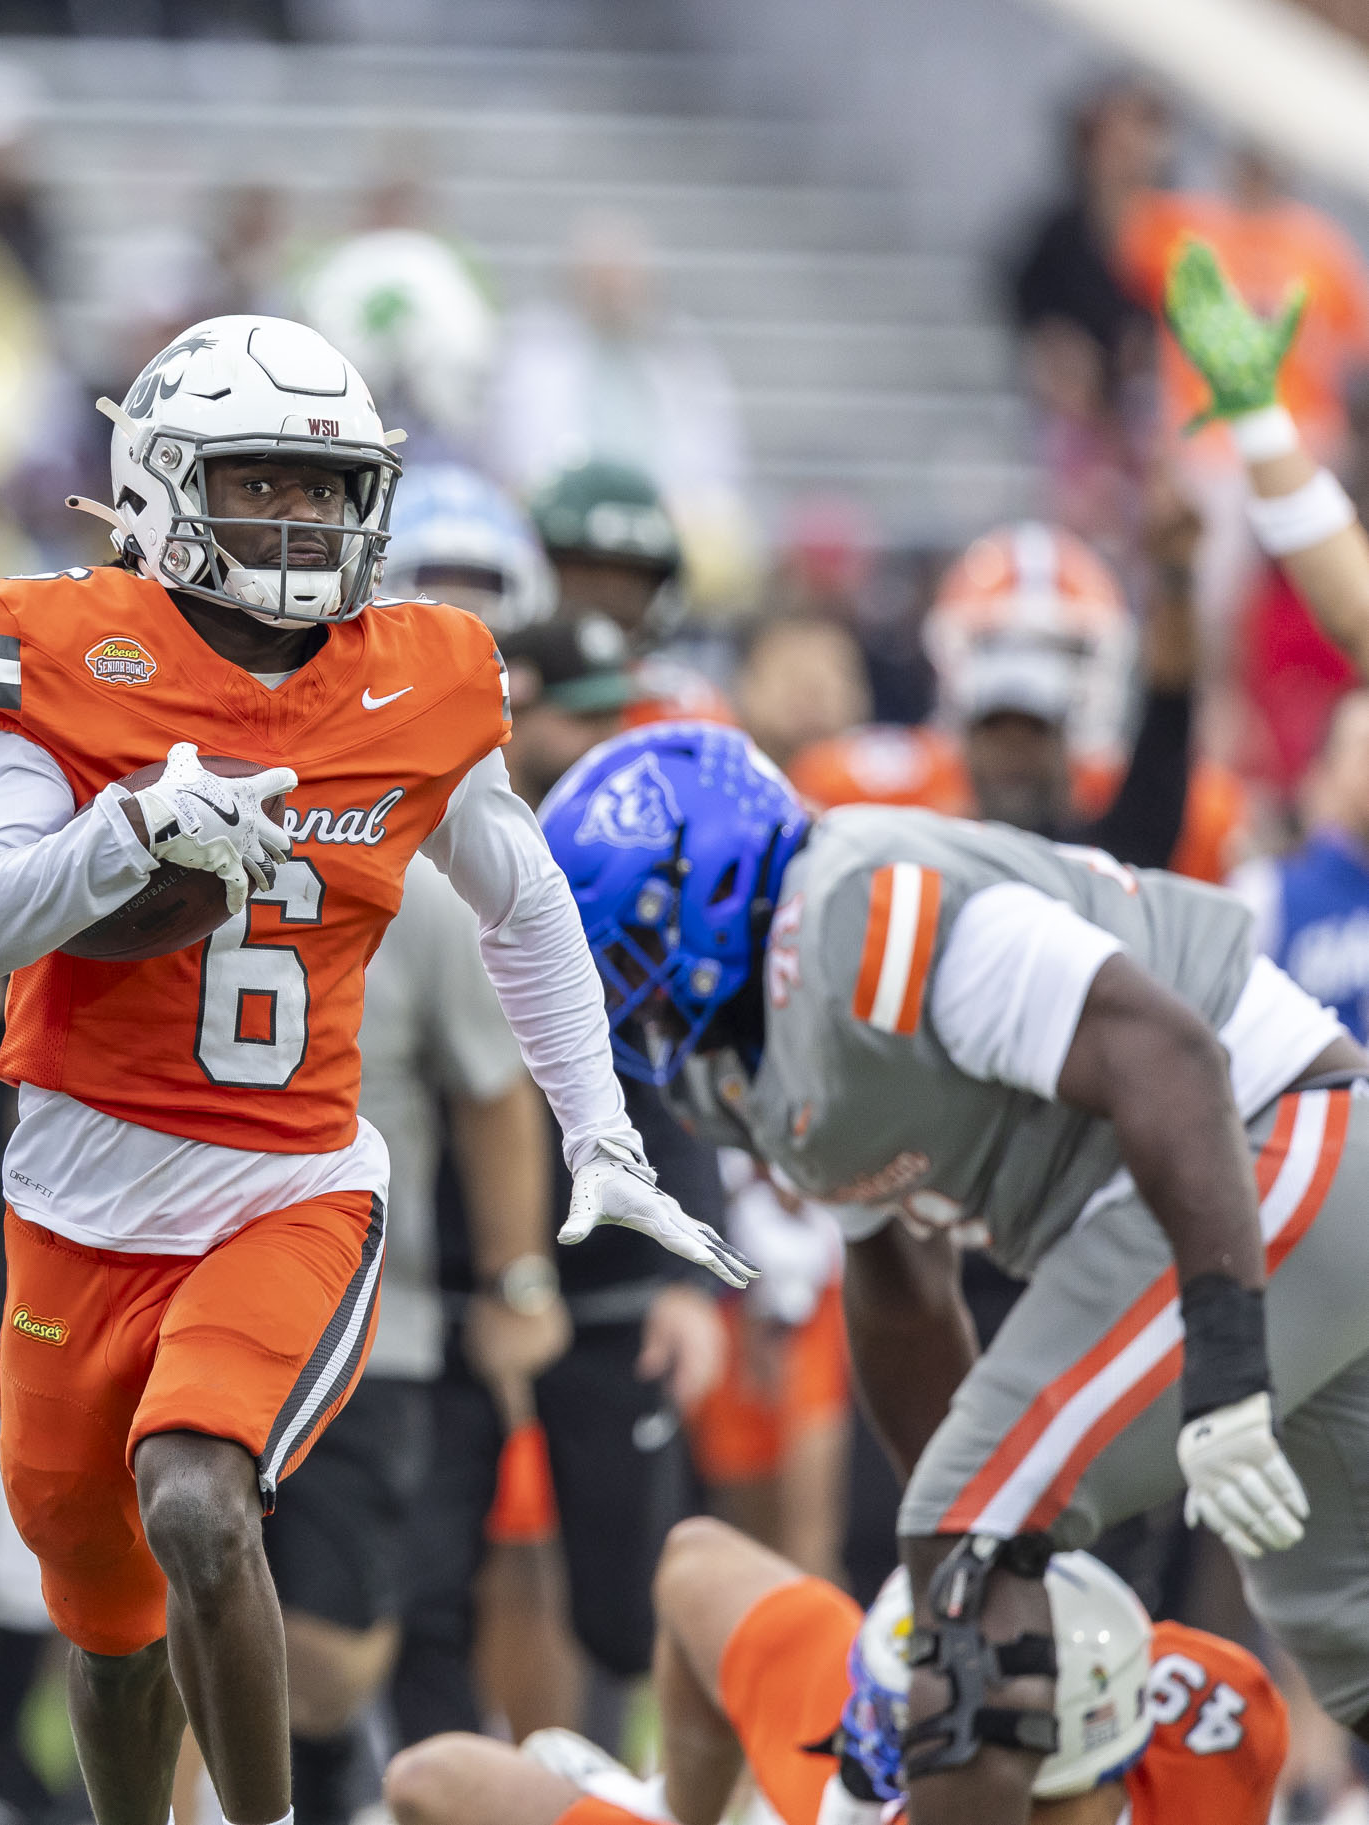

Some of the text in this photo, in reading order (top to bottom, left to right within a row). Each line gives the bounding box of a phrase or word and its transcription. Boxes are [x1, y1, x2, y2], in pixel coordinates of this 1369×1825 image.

[307, 418, 340, 438] WSU
[103, 644, 140, 658] Reese's
[97, 659, 147, 677] SENIOR BOWL
[283, 786, 406, 846] onal
[125, 875, 178, 912] FOOTBALL
[193, 856, 327, 1090] 6
[9, 1169, 54, 1198] DRI-FIT
[13, 1310, 64, 1340] Reese's
